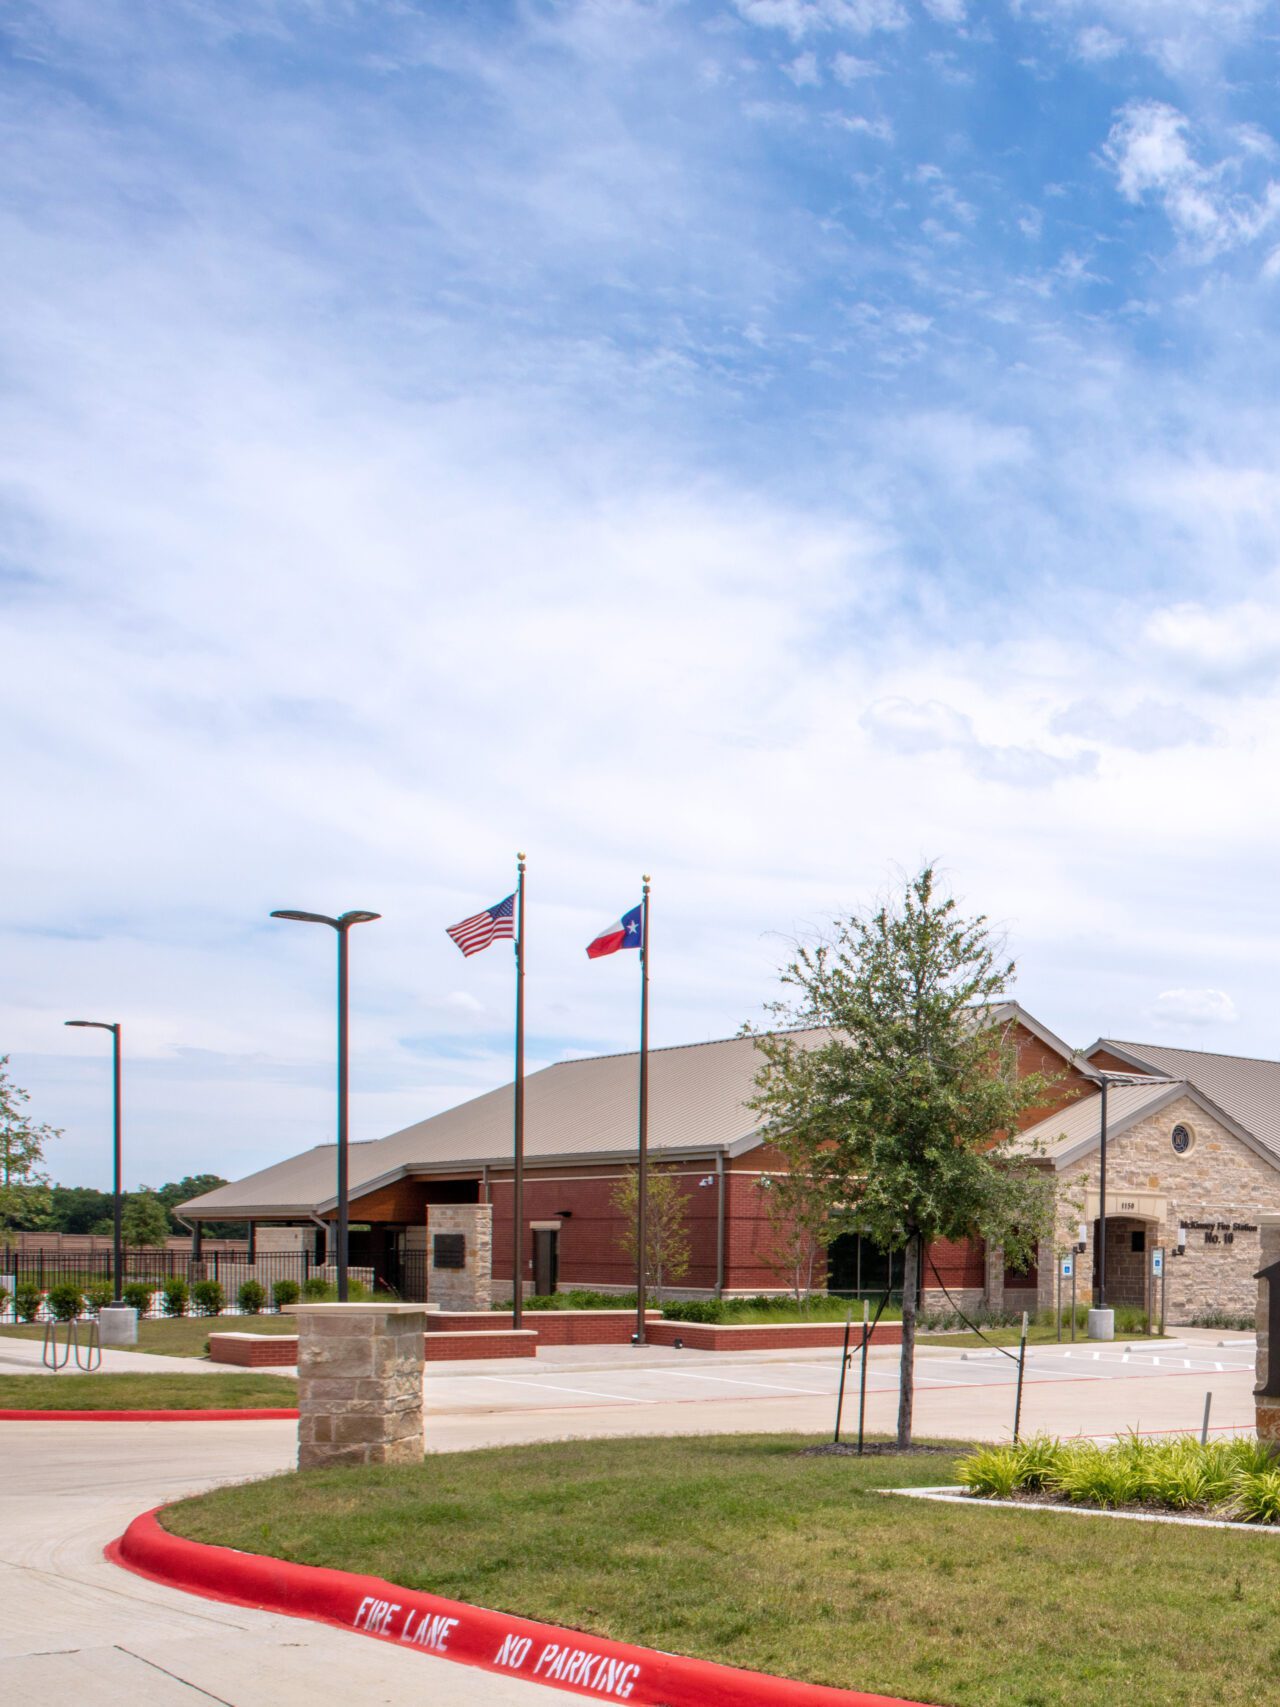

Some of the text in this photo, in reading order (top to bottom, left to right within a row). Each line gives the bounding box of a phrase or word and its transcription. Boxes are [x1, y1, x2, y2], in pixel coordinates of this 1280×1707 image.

[1180, 1220, 1258, 1232] McKinney Fire Station
[1204, 1232, 1234, 1244] No. 10
[353, 1596, 641, 1699] FIRE LANE NO PARKING
